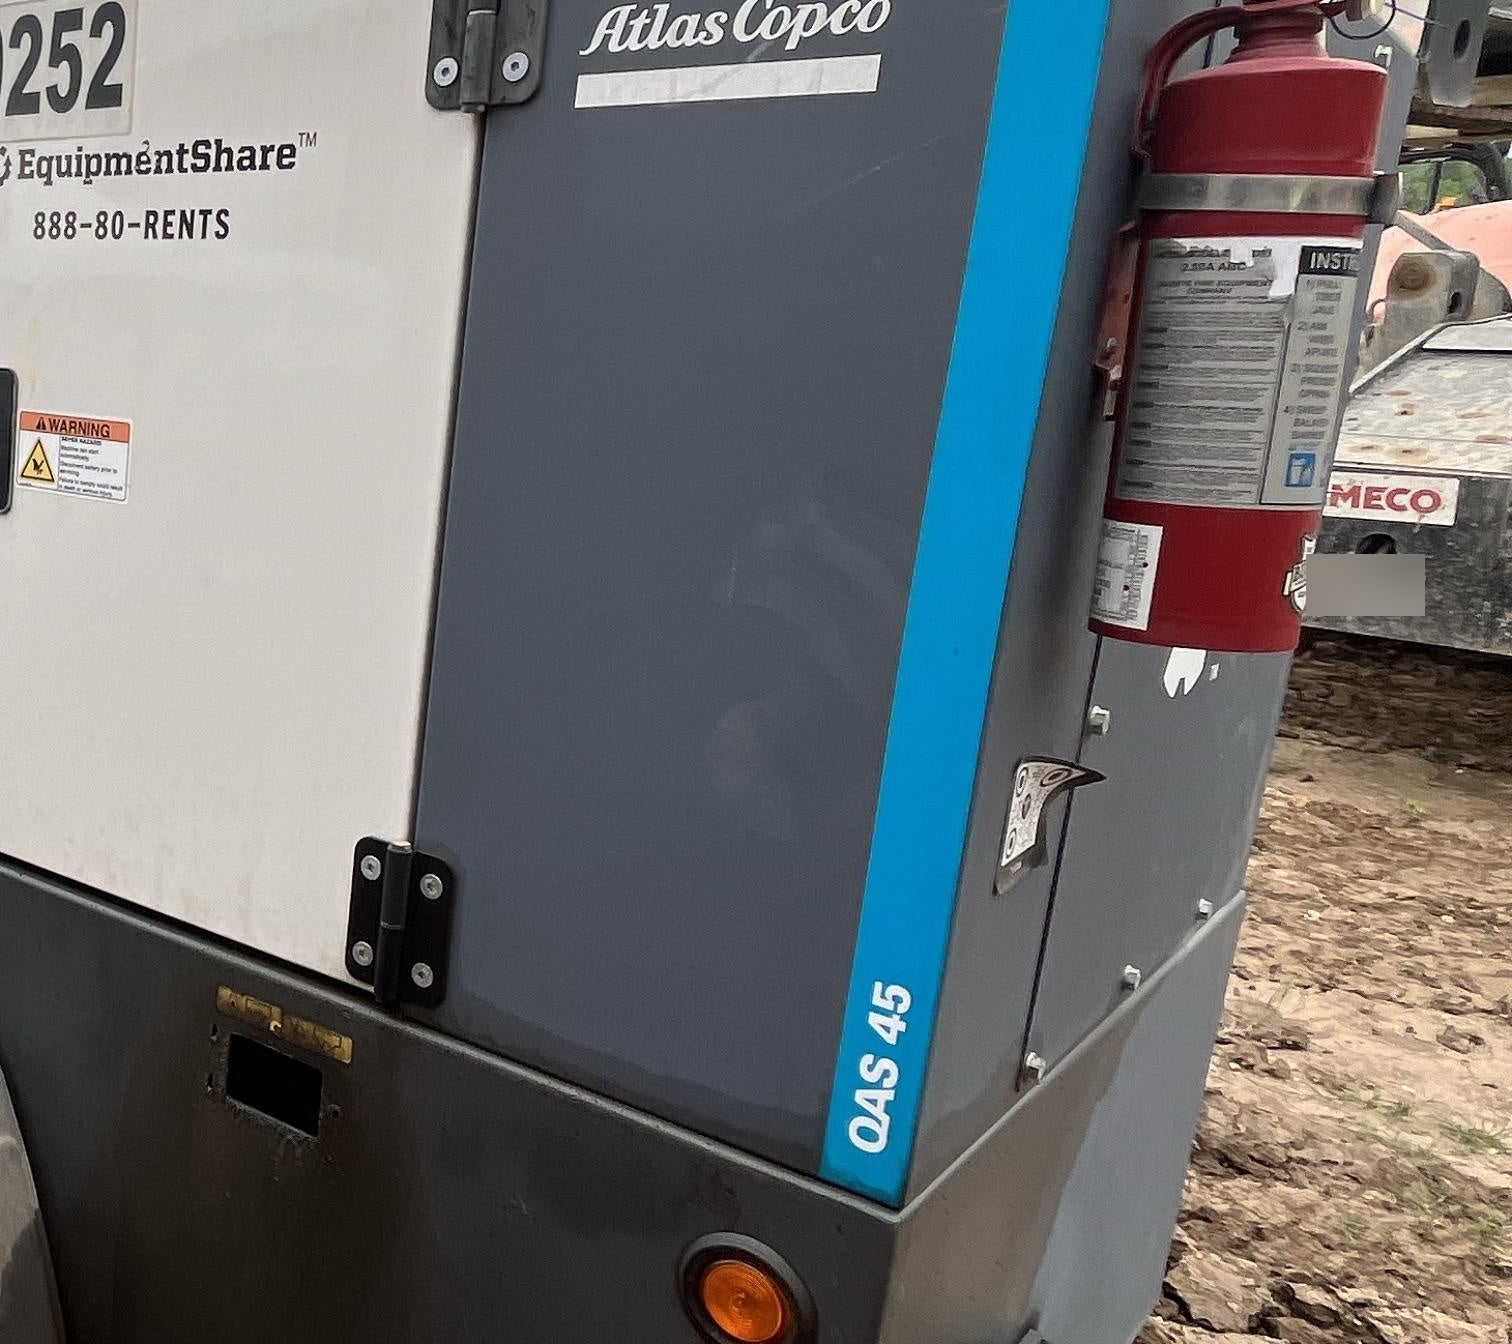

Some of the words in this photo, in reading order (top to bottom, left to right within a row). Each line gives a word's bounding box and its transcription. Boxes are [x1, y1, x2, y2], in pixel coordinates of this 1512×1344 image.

[578, 3, 729, 56] Atlas
[17, 139, 297, 185] EquipmentShare
[33, 209, 230, 240] 888-80-RENTS
[1310, 251, 1360, 272] INST
[48, 417, 111, 438] WARNING
[1329, 484, 1441, 514] MECO
[868, 981, 912, 1045] 45
[849, 1054, 900, 1153] QAS
